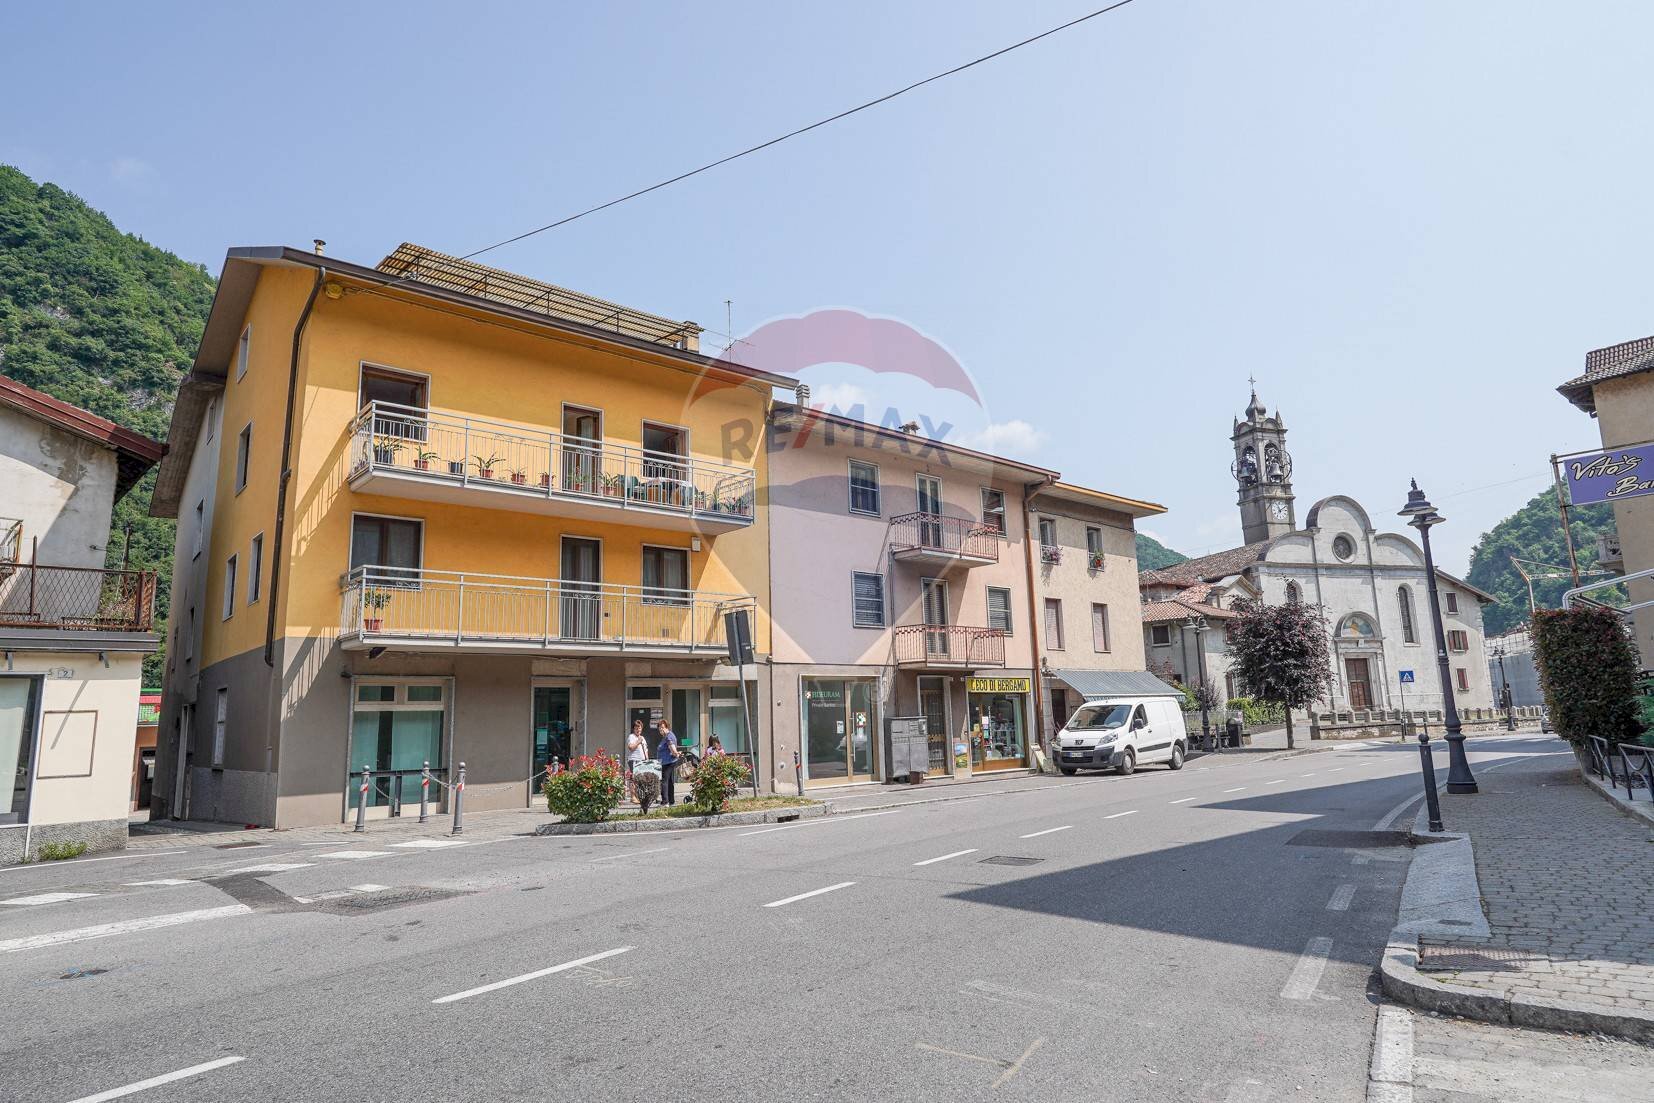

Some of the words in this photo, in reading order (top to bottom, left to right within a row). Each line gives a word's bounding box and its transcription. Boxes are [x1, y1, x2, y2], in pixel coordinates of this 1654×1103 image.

[1571, 455, 1642, 481] Vito's
[989, 679, 997, 692] DI
[997, 679, 1027, 692] BERGAMO
